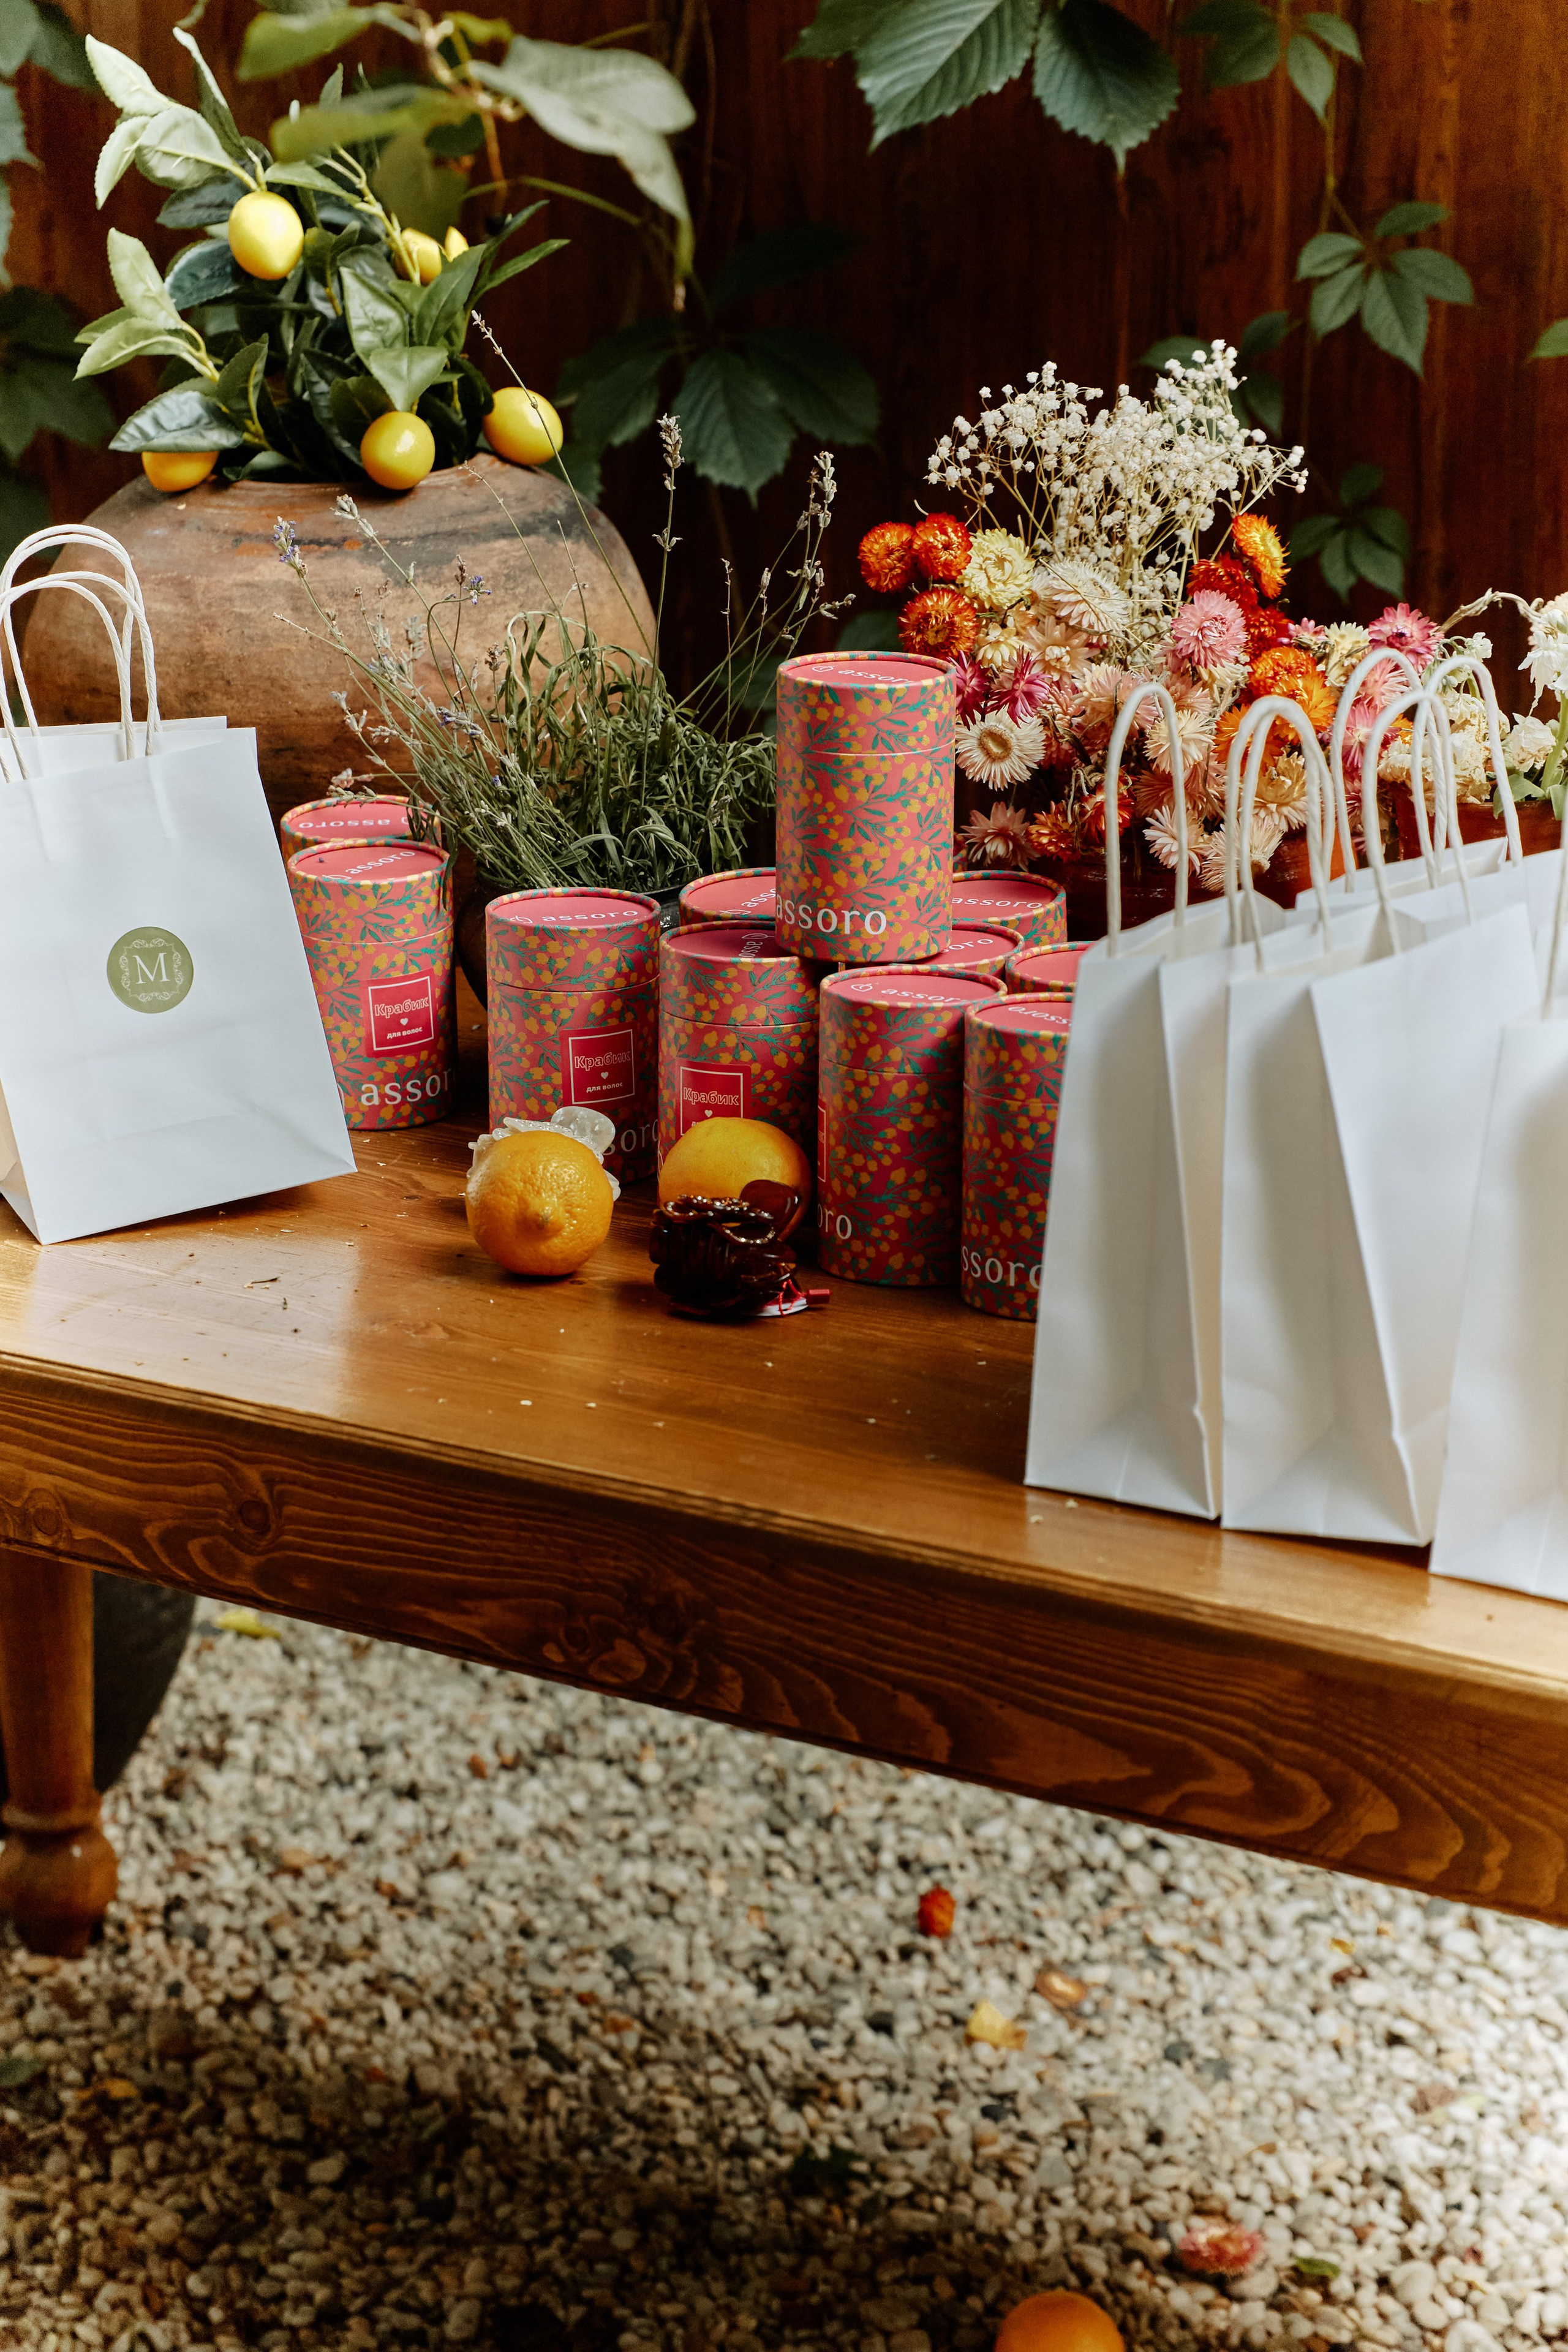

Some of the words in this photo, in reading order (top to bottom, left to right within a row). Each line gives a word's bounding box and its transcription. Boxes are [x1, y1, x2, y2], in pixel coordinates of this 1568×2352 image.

[299, 819, 390, 829] assoro
[345, 851, 415, 875] assoro
[951, 898, 1042, 908] assoro
[542, 911, 638, 921] assoro
[776, 894, 887, 935] assoro
[739, 941, 763, 958] asso
[132, 952, 170, 984] M
[881, 989, 961, 1003] assor
[374, 997, 429, 1018] Крабик
[1008, 1006, 1072, 1026] ssoro
[402, 1027, 423, 1035] волос
[574, 1051, 631, 1071] Крабик
[361, 1068, 456, 1106] assor
[586, 1085, 601, 1093] для
[602, 1082, 624, 1090] волос
[683, 1087, 739, 1105] Крабик
